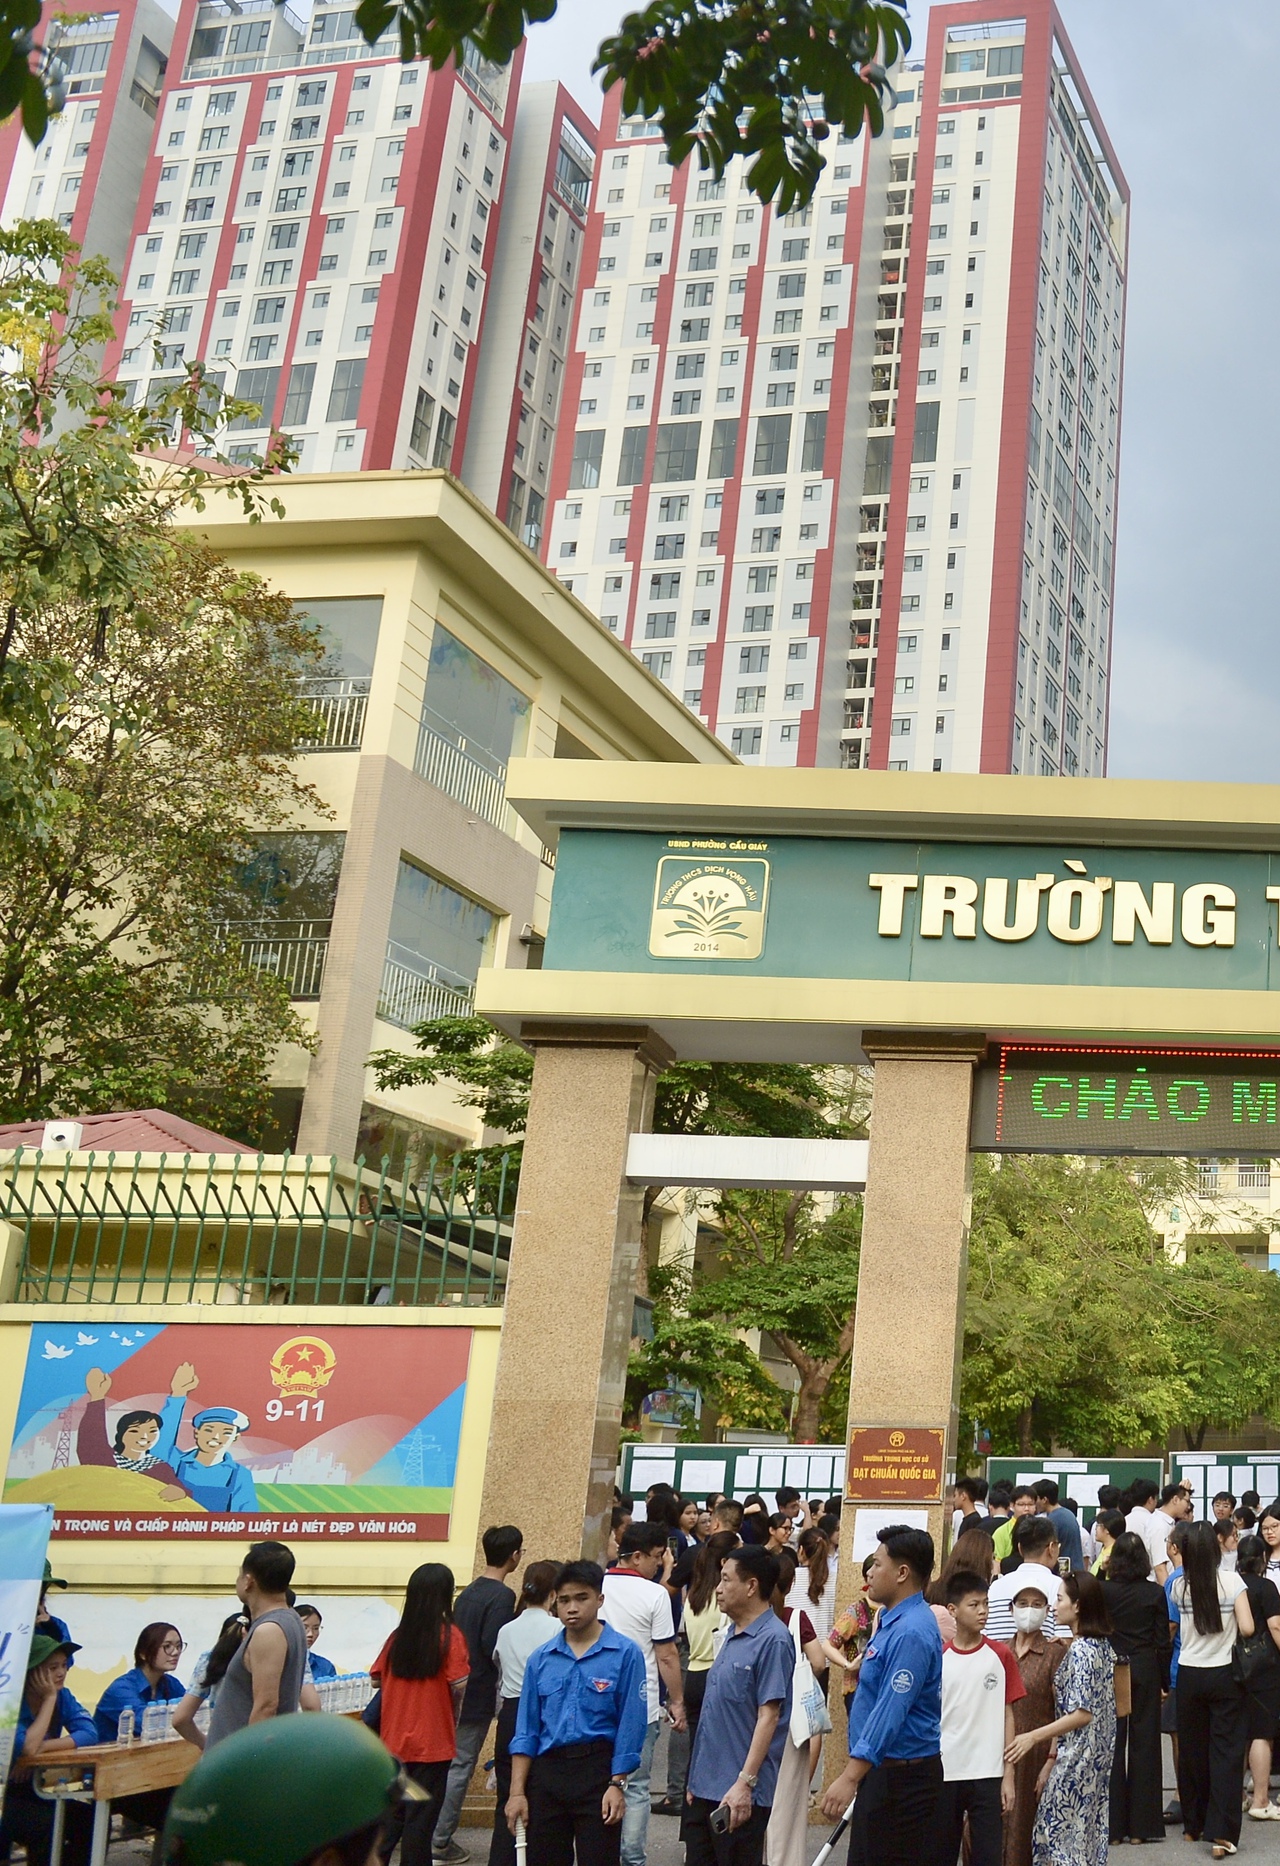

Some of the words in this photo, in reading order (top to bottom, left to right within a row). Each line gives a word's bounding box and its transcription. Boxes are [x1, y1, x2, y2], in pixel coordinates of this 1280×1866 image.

[681, 868, 702, 882] THCS
[704, 866, 725, 875] DỊCH
[868, 859, 1237, 949] TRƯỜNG
[693, 943, 720, 952] 2014
[265, 1399, 325, 1422] 9-11
[853, 1468, 869, 1480] ĐẠT
[870, 1464, 898, 1479] CHUẨN
[899, 1465, 921, 1480] QUỐC
[922, 1469, 936, 1479] GIA
[64, 1519, 110, 1533] TRỌNG
[113, 1516, 132, 1532] VÀ
[135, 1516, 170, 1533] CHẤP
[172, 1517, 208, 1533] HÀNH
[211, 1517, 246, 1533] PHÁP
[248, 1518, 284, 1536] LUẬT
[283, 1518, 299, 1533] LÀ
[302, 1518, 327, 1534] NÉT
[329, 1519, 355, 1537] ĐẸP
[358, 1518, 386, 1534] VĂN
[388, 1518, 416, 1534] HÓA
